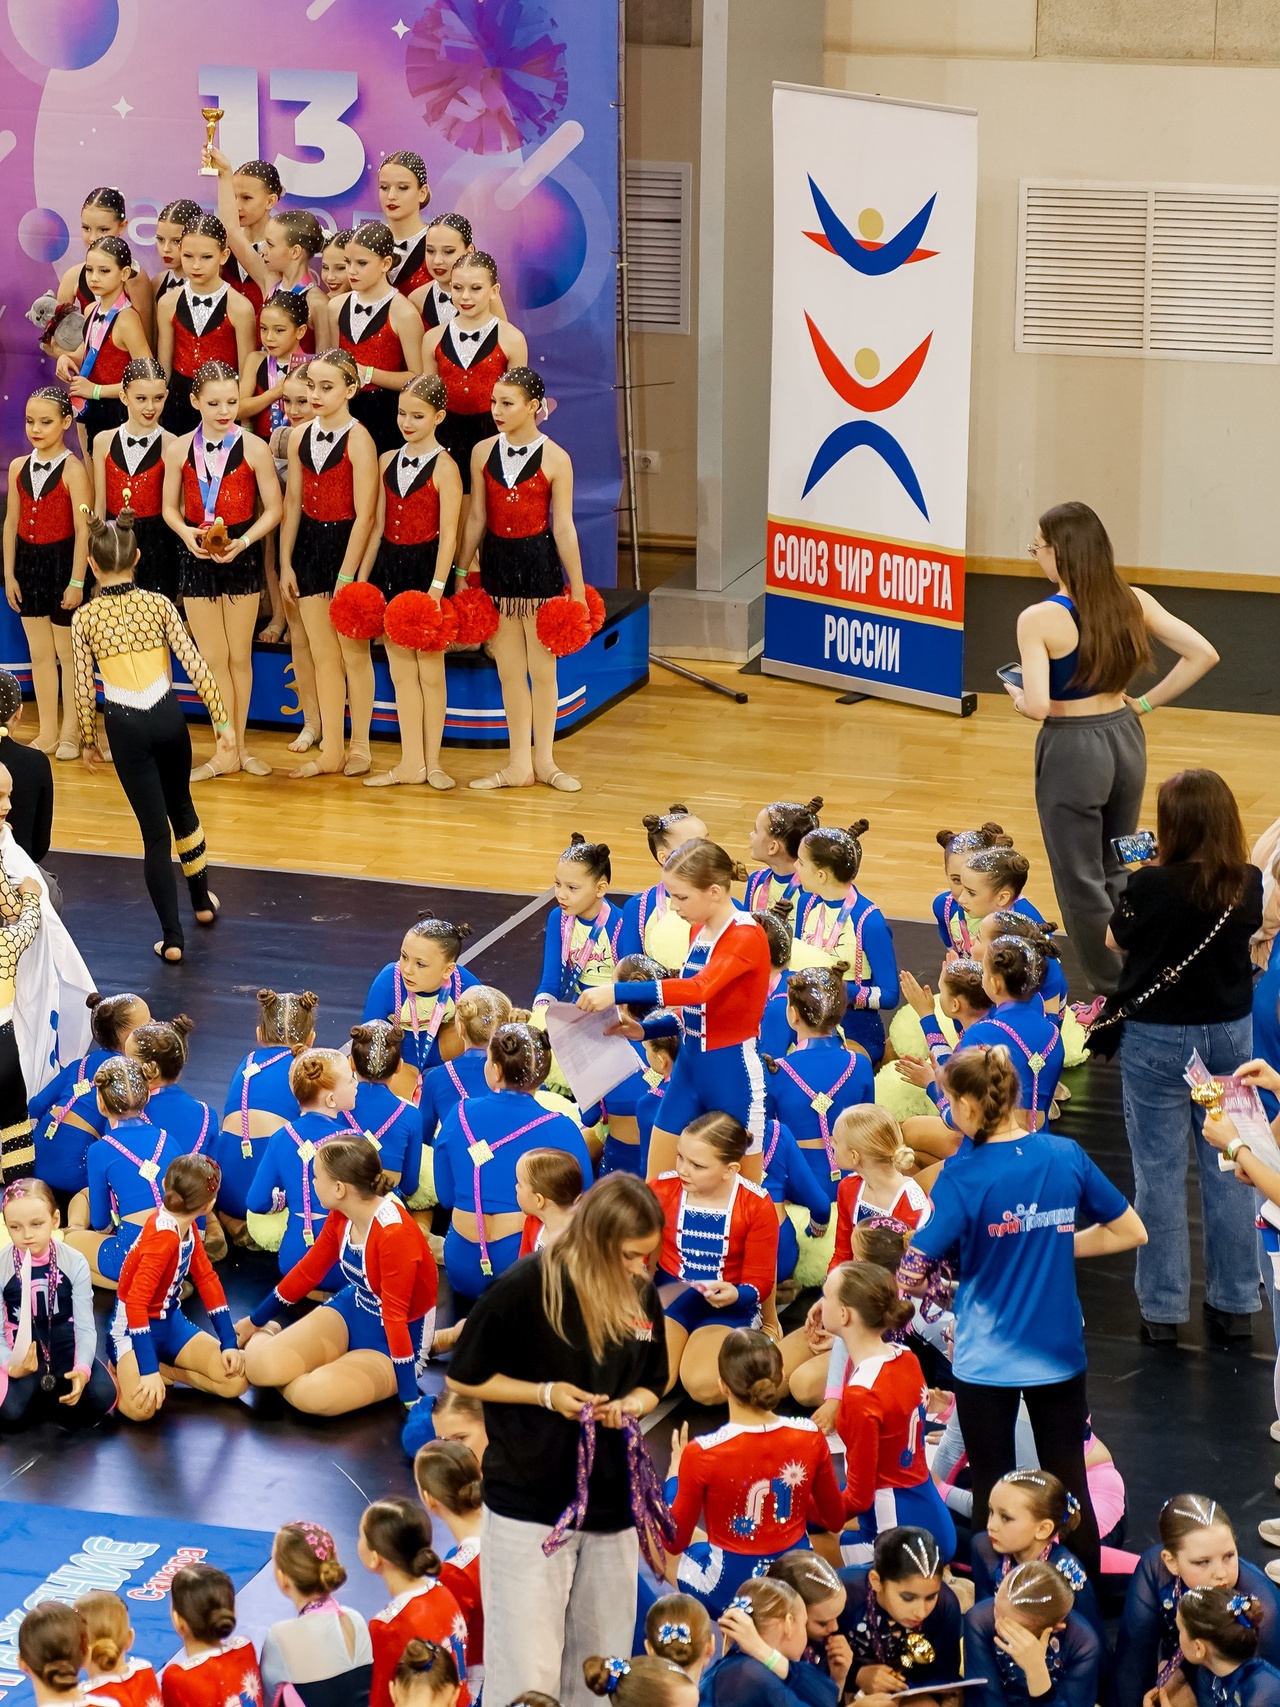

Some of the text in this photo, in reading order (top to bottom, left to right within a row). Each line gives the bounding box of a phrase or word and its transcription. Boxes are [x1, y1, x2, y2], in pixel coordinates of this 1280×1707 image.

[198, 64, 366, 198] 13
[773, 532, 953, 611] СОЮЗ ЧИР СПОРТА
[824, 614, 901, 673] РОССИИ
